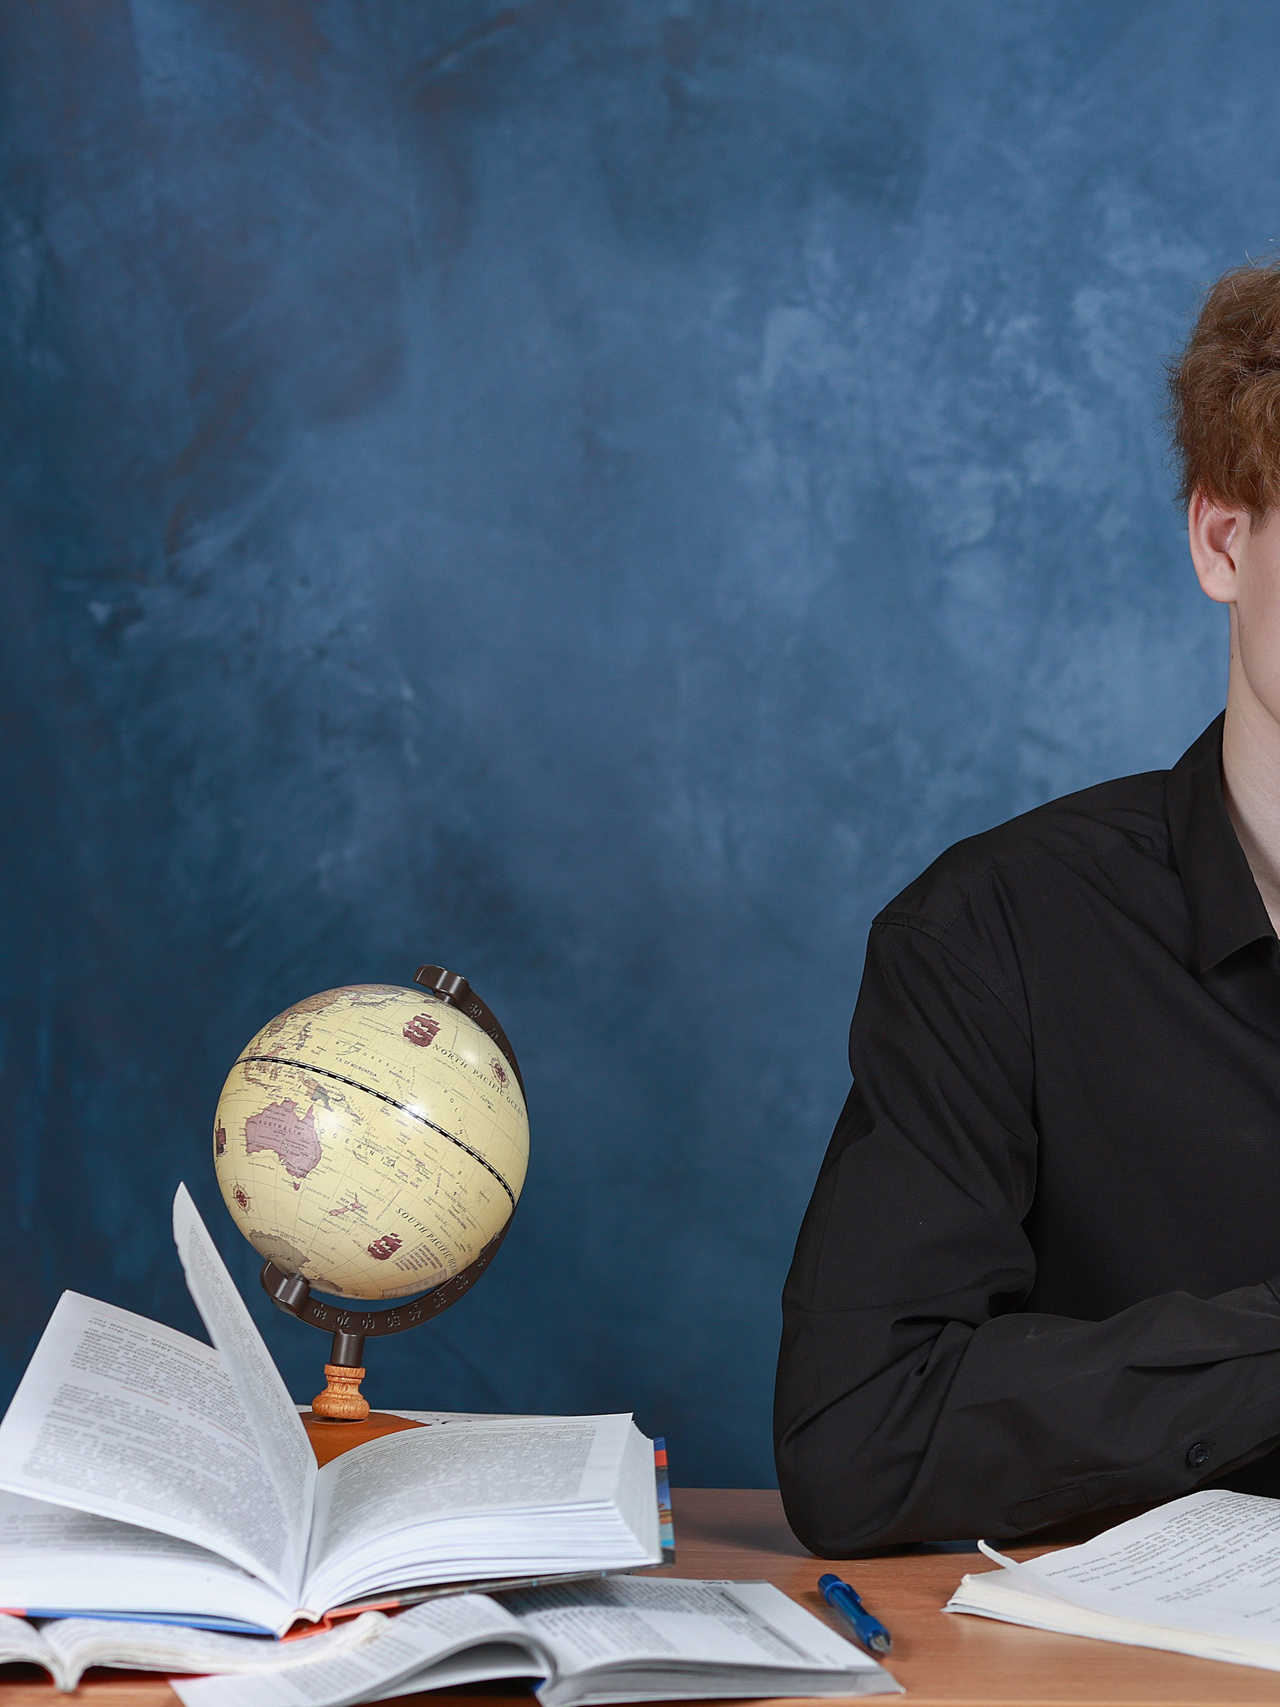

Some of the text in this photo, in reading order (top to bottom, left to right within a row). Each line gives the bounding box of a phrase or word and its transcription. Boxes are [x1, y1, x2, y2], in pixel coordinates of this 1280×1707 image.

[432, 1044, 468, 1069] NORTH
[472, 1069, 505, 1098] PACIFIC
[258, 1120, 302, 1137] AUSTRALIA
[396, 1207, 428, 1234] SOUTH
[426, 1233, 453, 1259] PACIFIC
